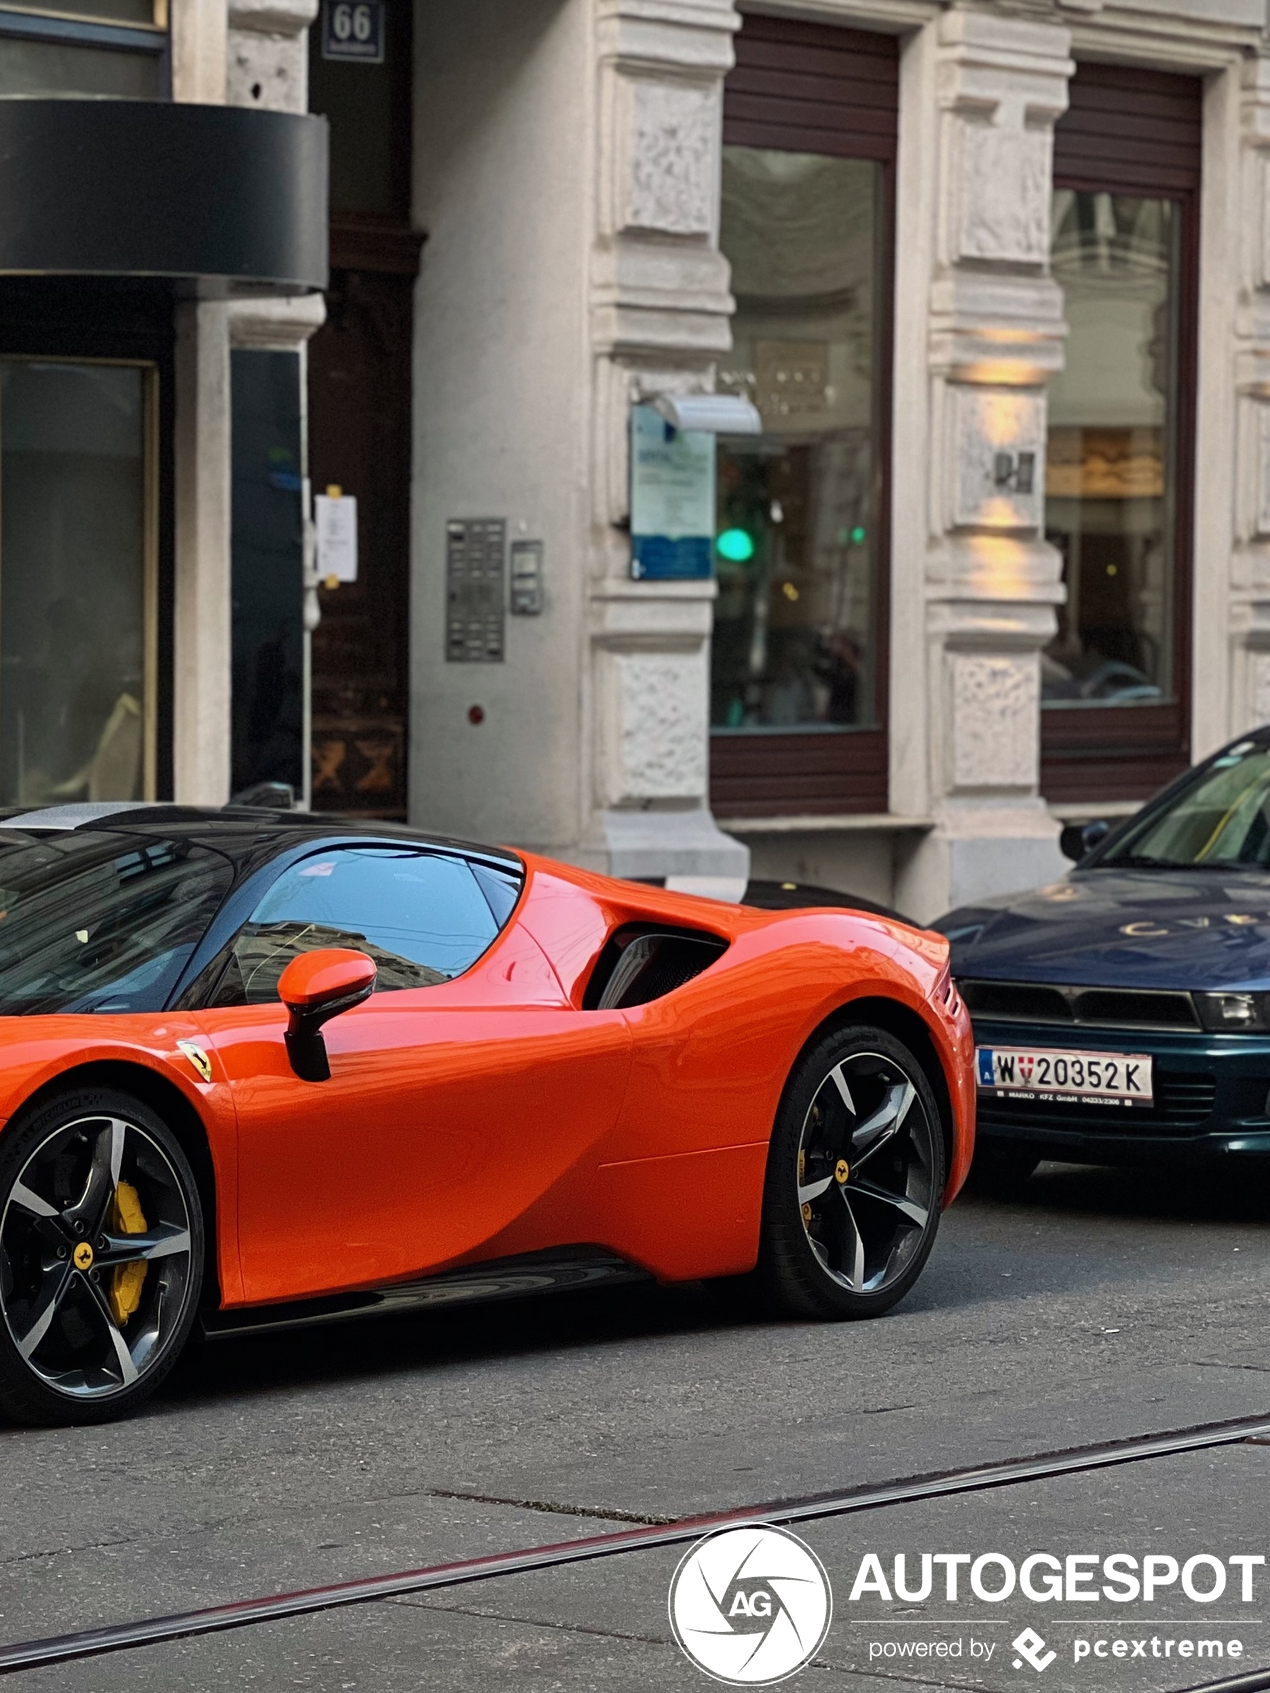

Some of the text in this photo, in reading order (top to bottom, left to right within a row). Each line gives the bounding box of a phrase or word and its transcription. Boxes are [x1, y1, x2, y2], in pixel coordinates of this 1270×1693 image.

[333, 3, 371, 40] 66
[997, 1055, 1015, 1083] W
[1037, 1057, 1120, 1090] 20352
[1125, 1063, 1141, 1092] K
[1039, 1093, 1054, 1101] KFZ
[1056, 1094, 1078, 1102] GmbH
